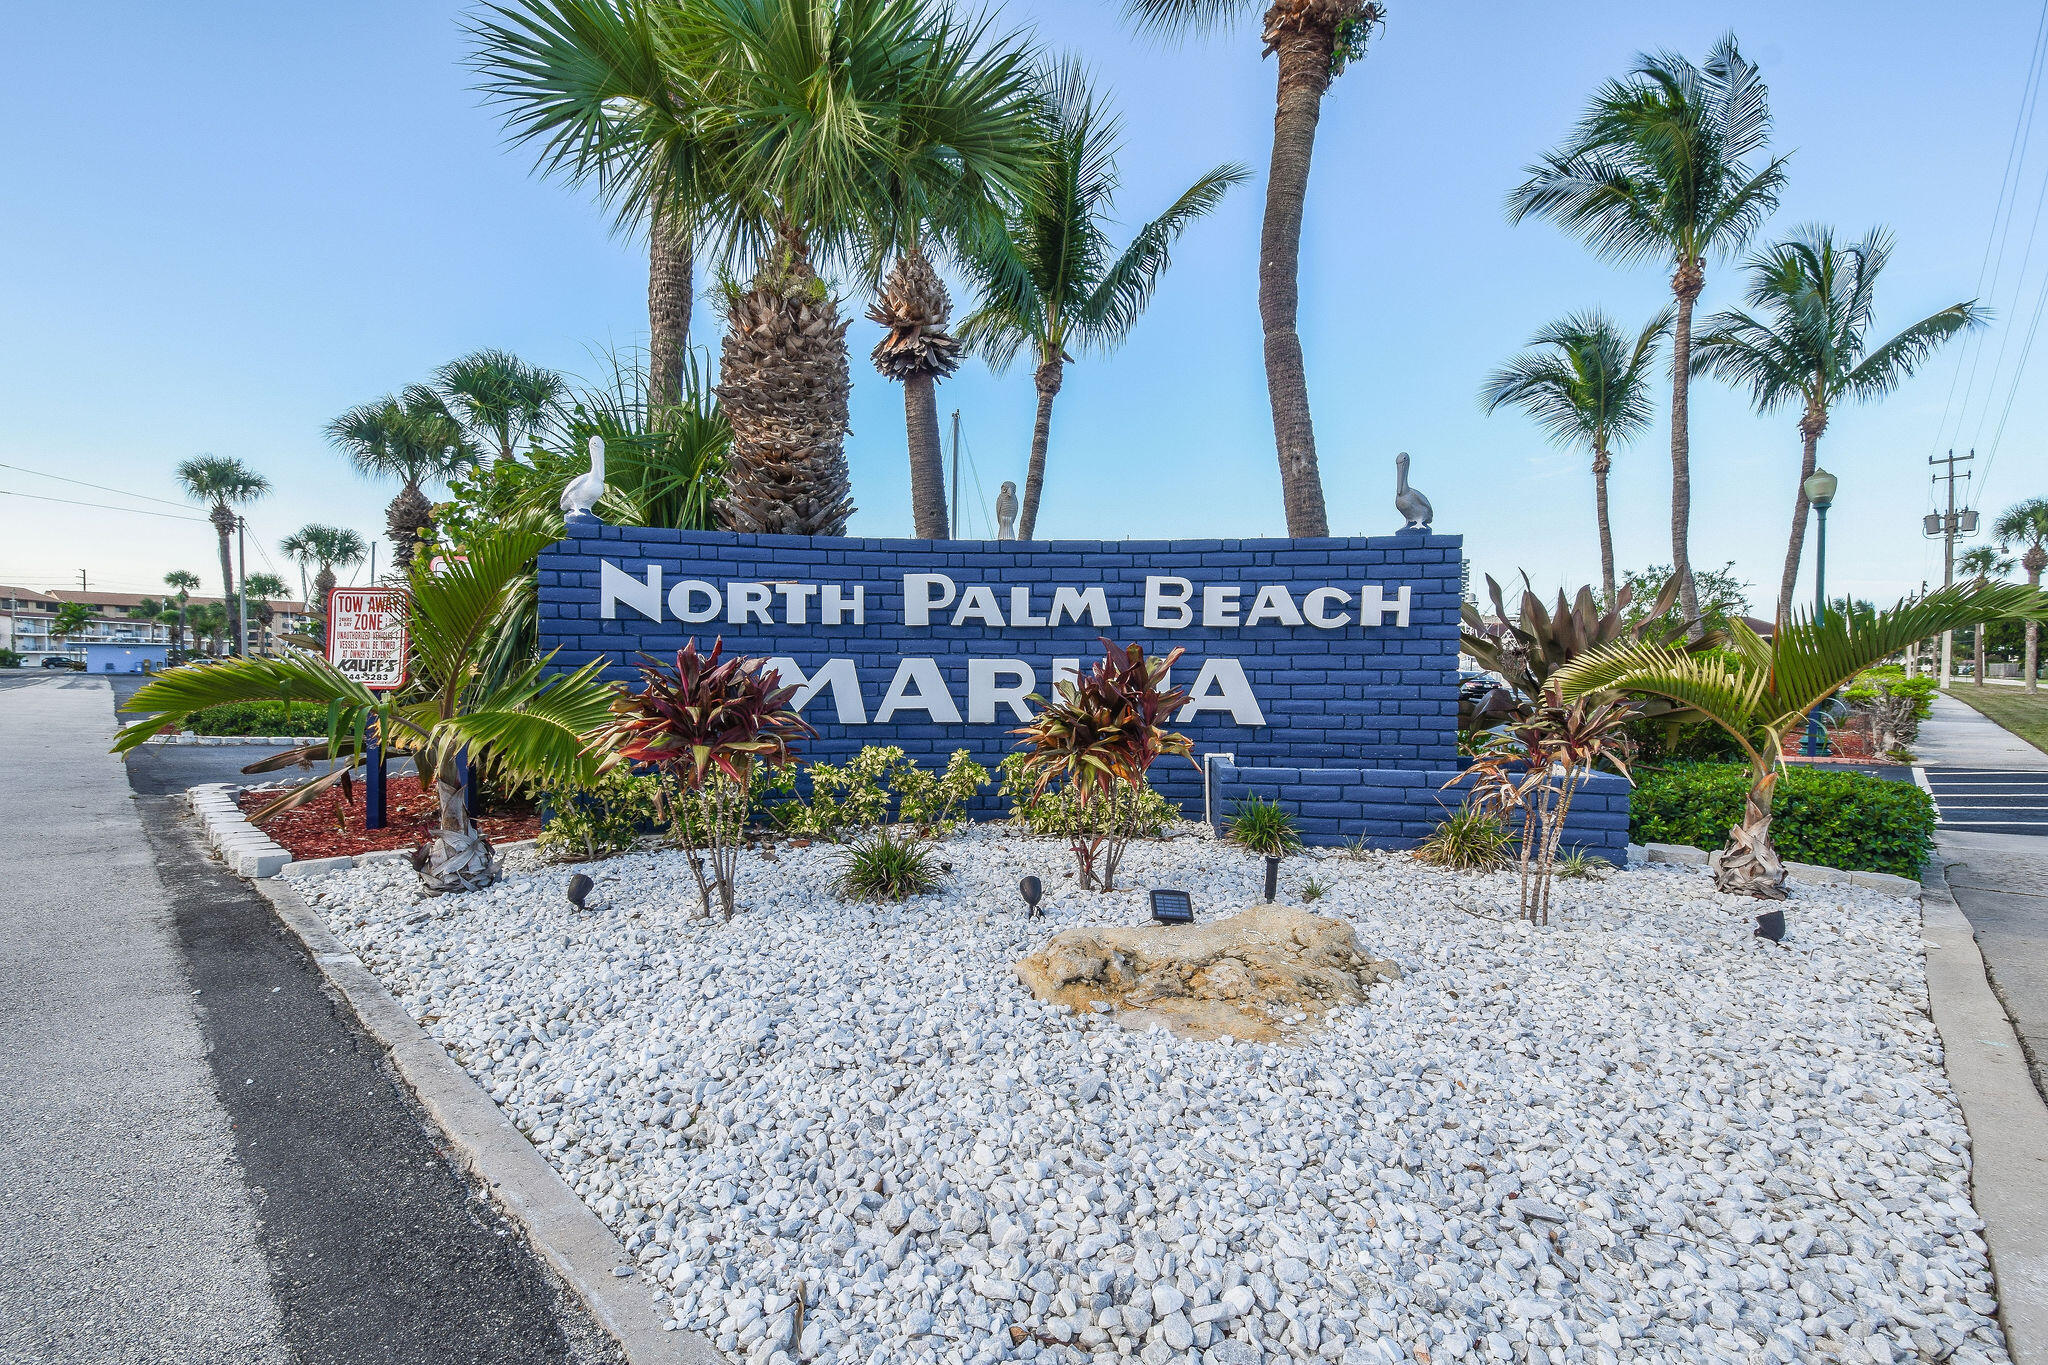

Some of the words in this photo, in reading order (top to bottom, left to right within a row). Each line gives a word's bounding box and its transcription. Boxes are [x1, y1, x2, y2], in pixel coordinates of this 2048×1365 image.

[600, 559, 864, 624] NORTH
[903, 573, 1112, 627] PALM
[1143, 575, 1411, 628] BEACH
[338, 596, 363, 612] TOW
[354, 614, 383, 630] ZONE
[337, 631, 370, 639] UNAUTHORIZED
[340, 641, 358, 649] VESSELS
[360, 641, 370, 649] WILL
[373, 641, 380, 649] BE
[381, 641, 396, 649] TOWED
[342, 650, 348, 658] AT
[337, 659, 398, 672] KAUFF'S
[760, 656, 1267, 726] MARIA
